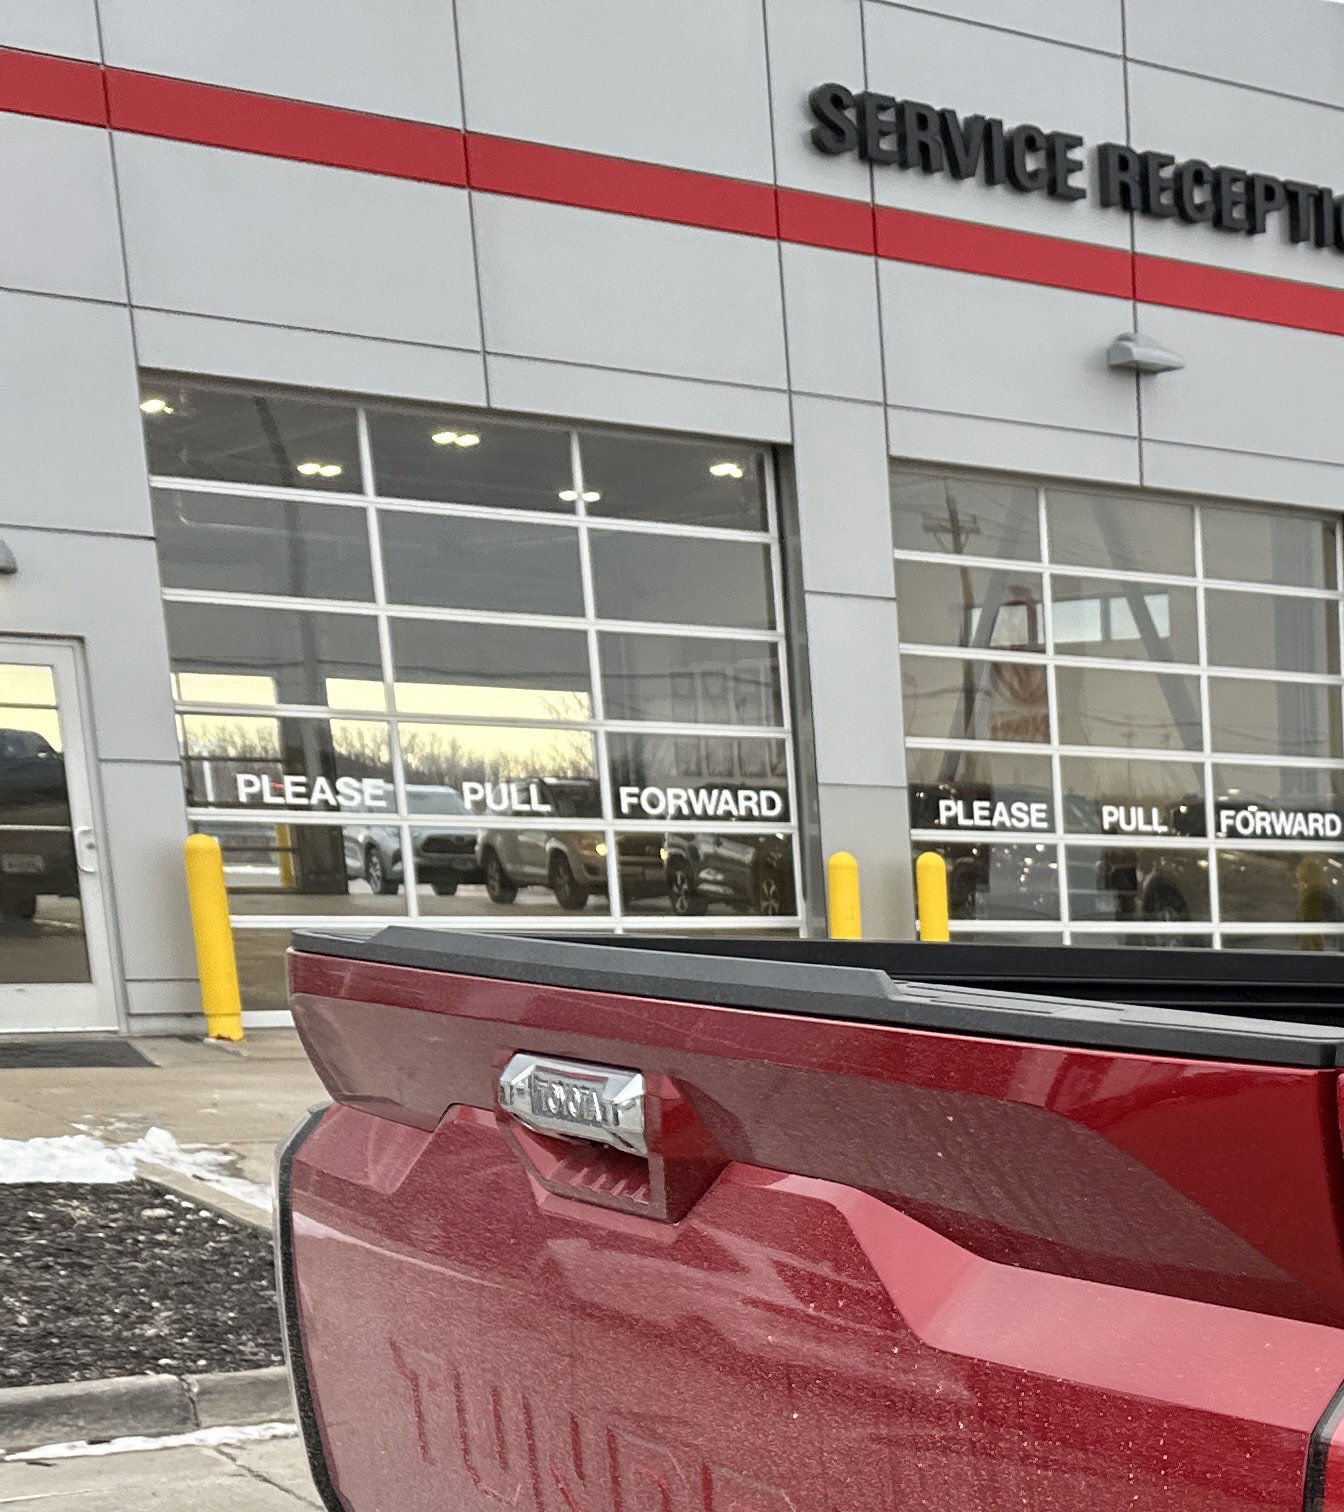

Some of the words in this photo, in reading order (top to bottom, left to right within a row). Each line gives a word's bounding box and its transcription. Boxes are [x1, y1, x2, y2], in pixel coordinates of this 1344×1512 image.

[808, 82, 1087, 201] SERVICE
[236, 772, 389, 808] PLEASE
[462, 781, 552, 814] PULL
[619, 785, 783, 818] FORWARD
[937, 799, 1049, 830] PLEASE
[1101, 804, 1169, 835] PULL
[1219, 808, 1343, 839] FORWARD
